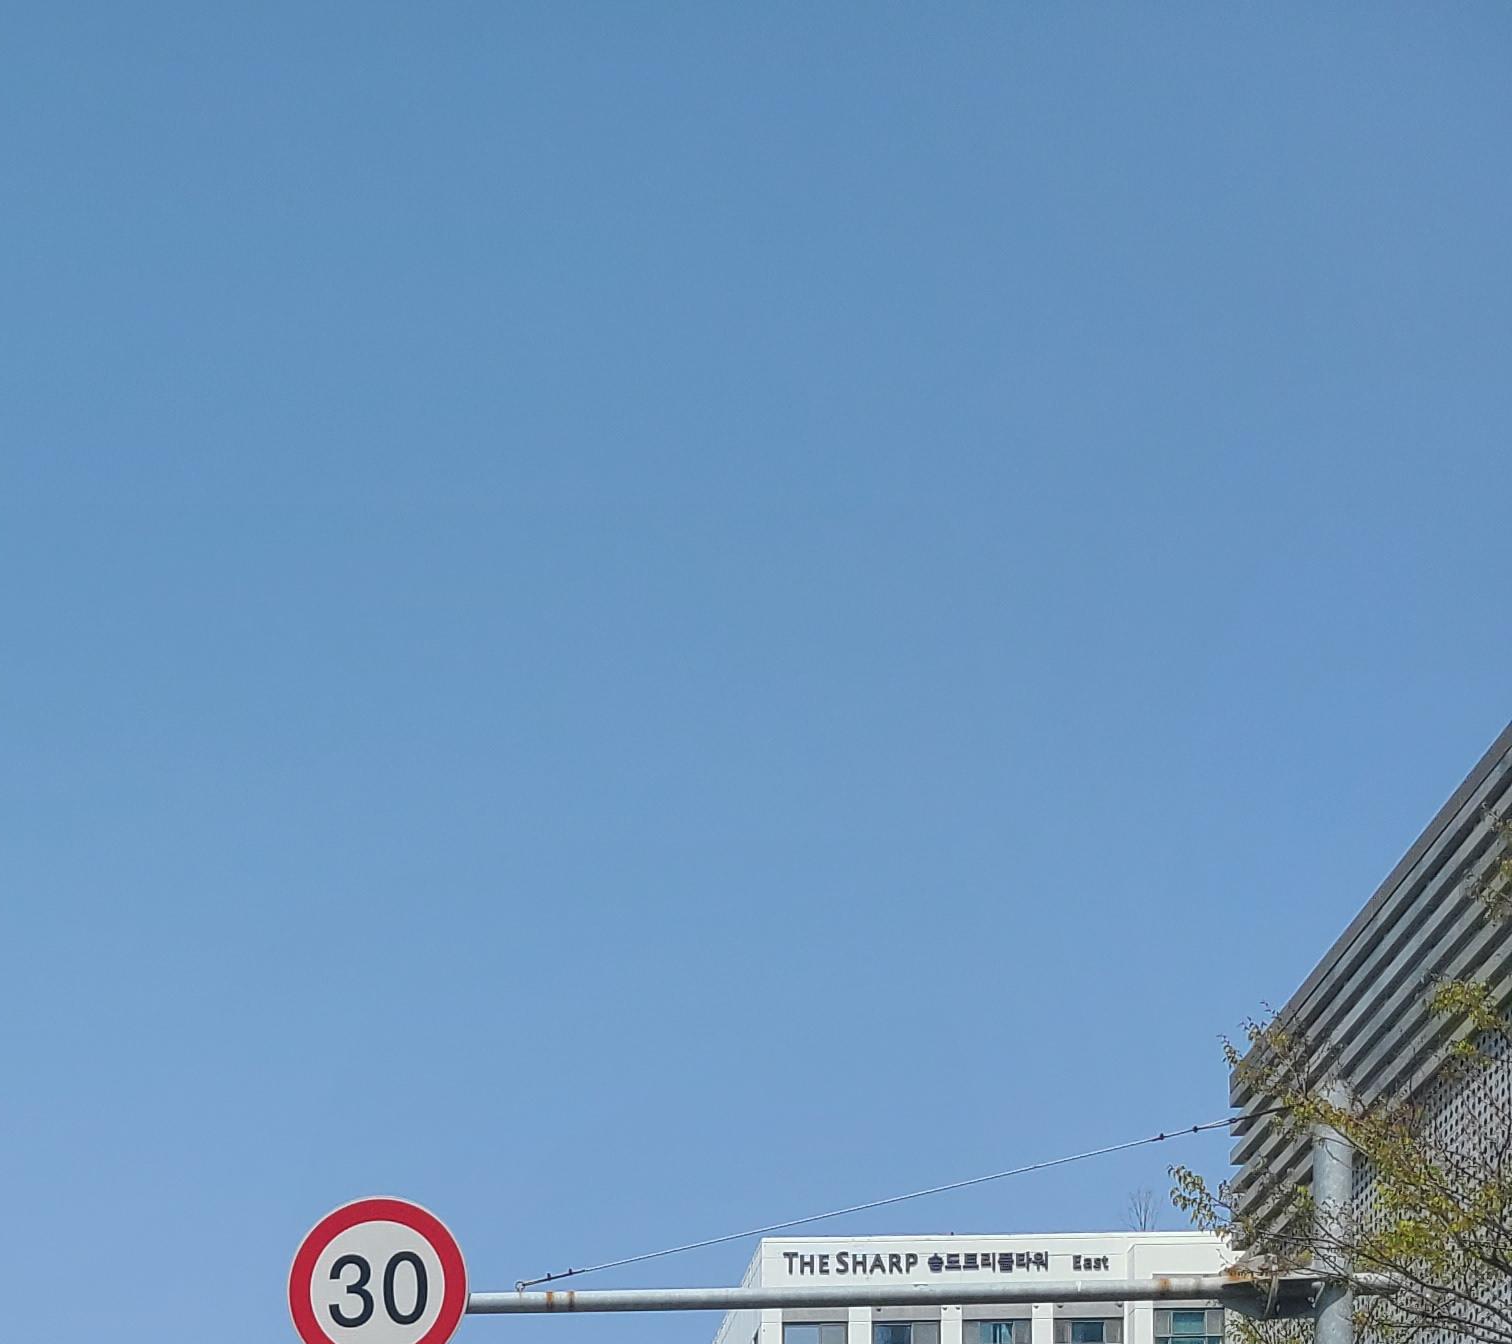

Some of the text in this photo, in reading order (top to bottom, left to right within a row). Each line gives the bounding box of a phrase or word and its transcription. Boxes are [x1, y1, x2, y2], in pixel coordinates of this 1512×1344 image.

[783, 1251, 830, 1275] THE
[835, 1251, 919, 1276] SHARP
[1072, 1254, 1110, 1272] East
[329, 1251, 428, 1328] 30
